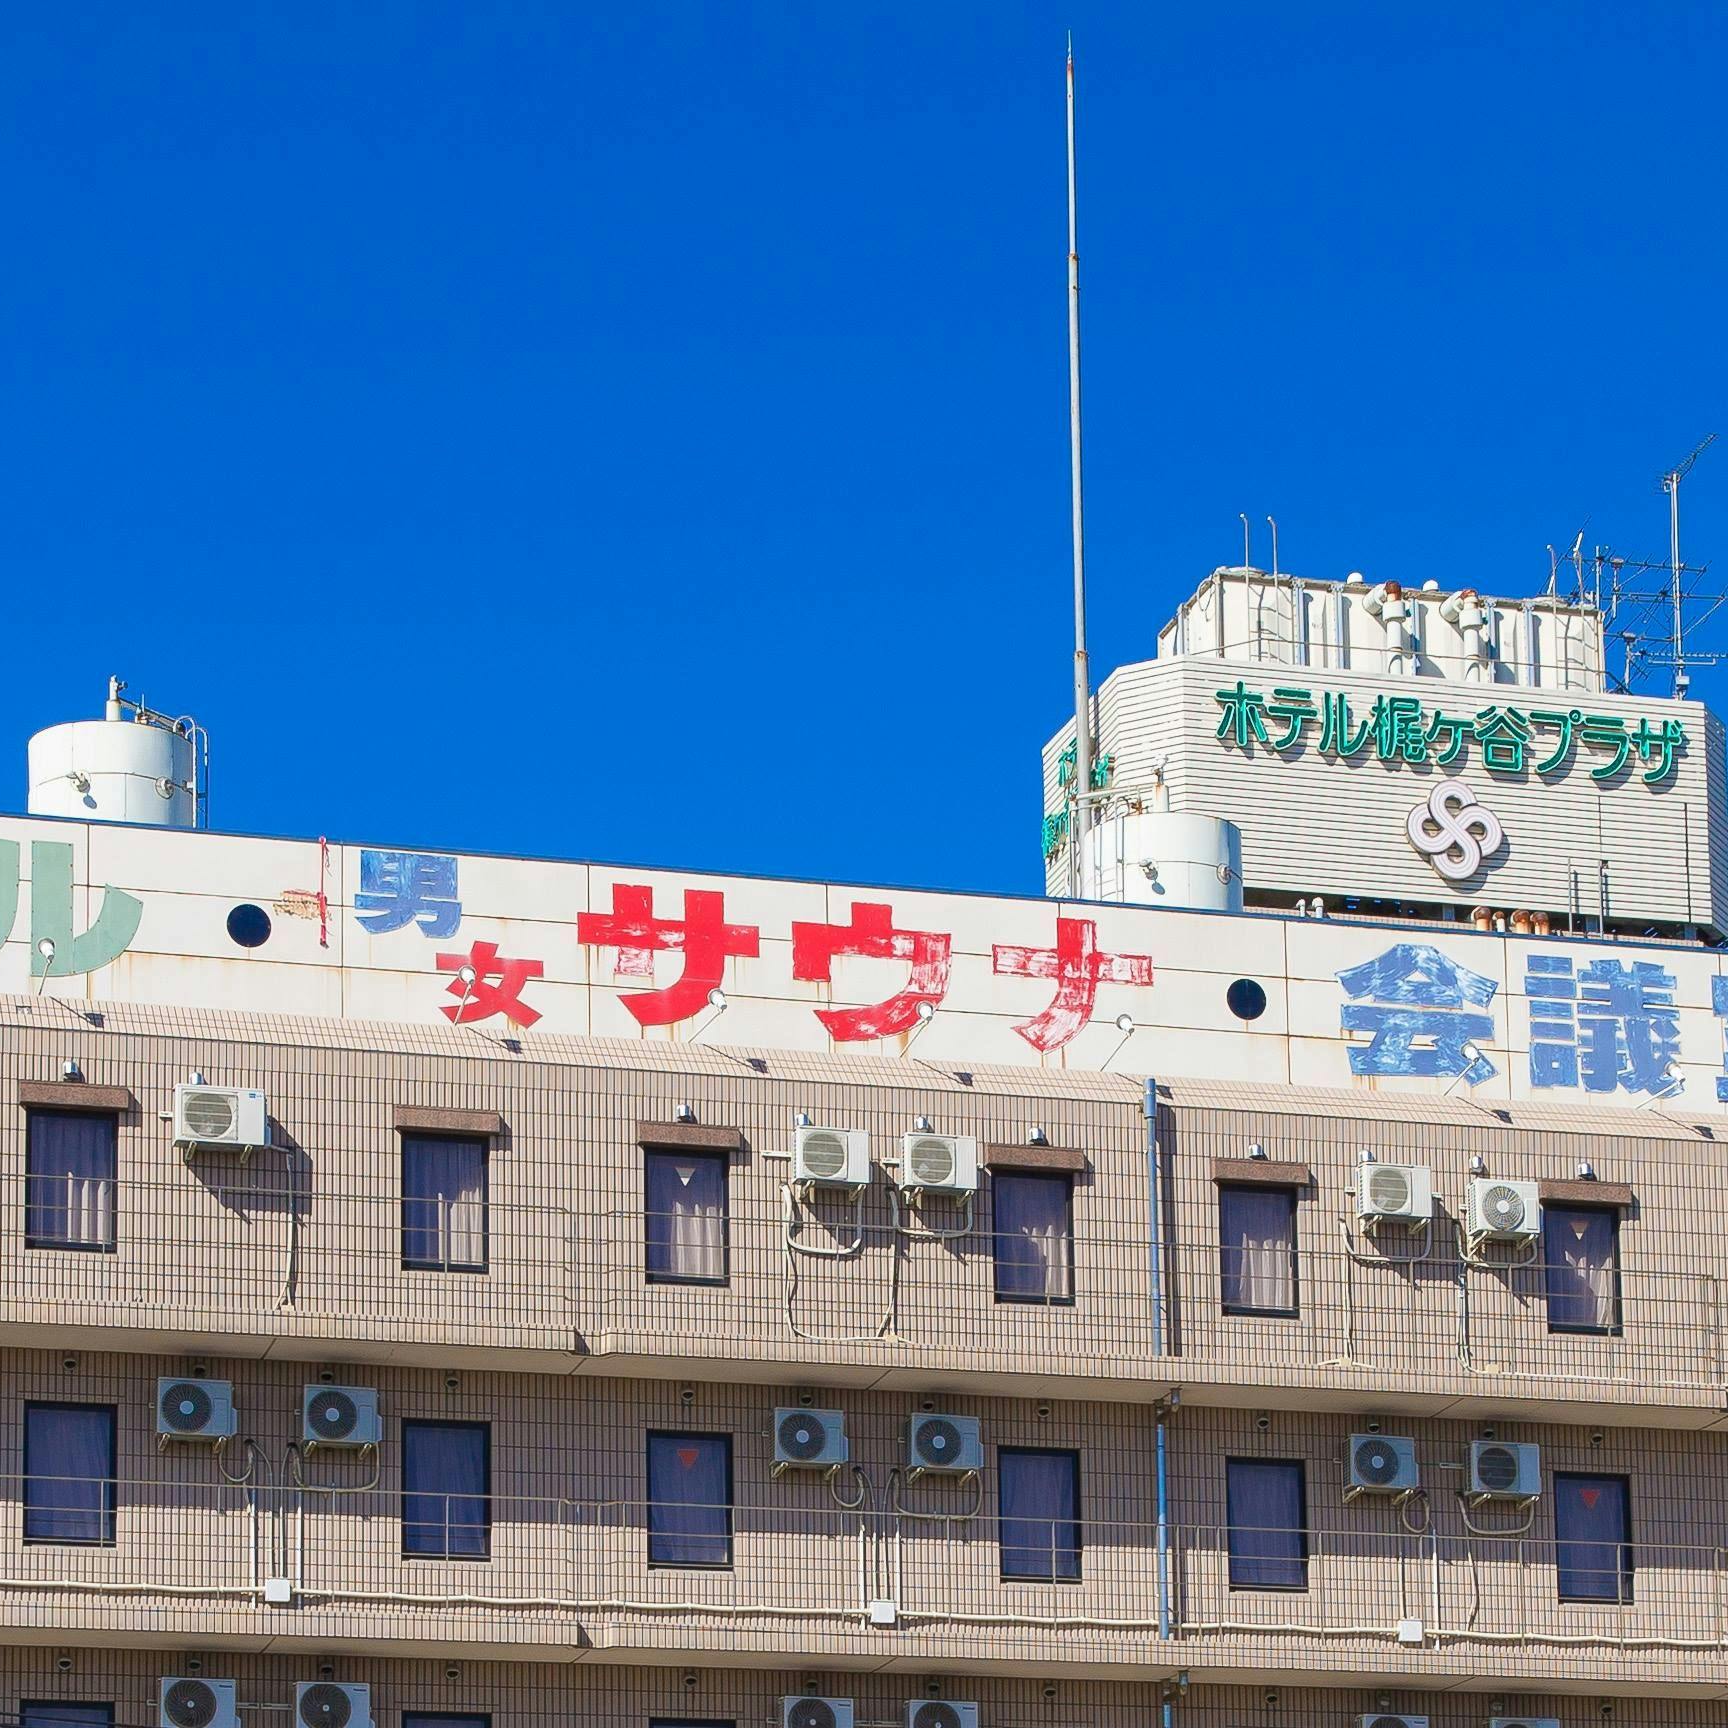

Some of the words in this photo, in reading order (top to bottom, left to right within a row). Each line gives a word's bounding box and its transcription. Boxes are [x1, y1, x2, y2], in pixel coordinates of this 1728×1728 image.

[355, 850, 462, 938] 男
[436, 941, 544, 1028] 女
[576, 882, 1154, 1055] サウナ
